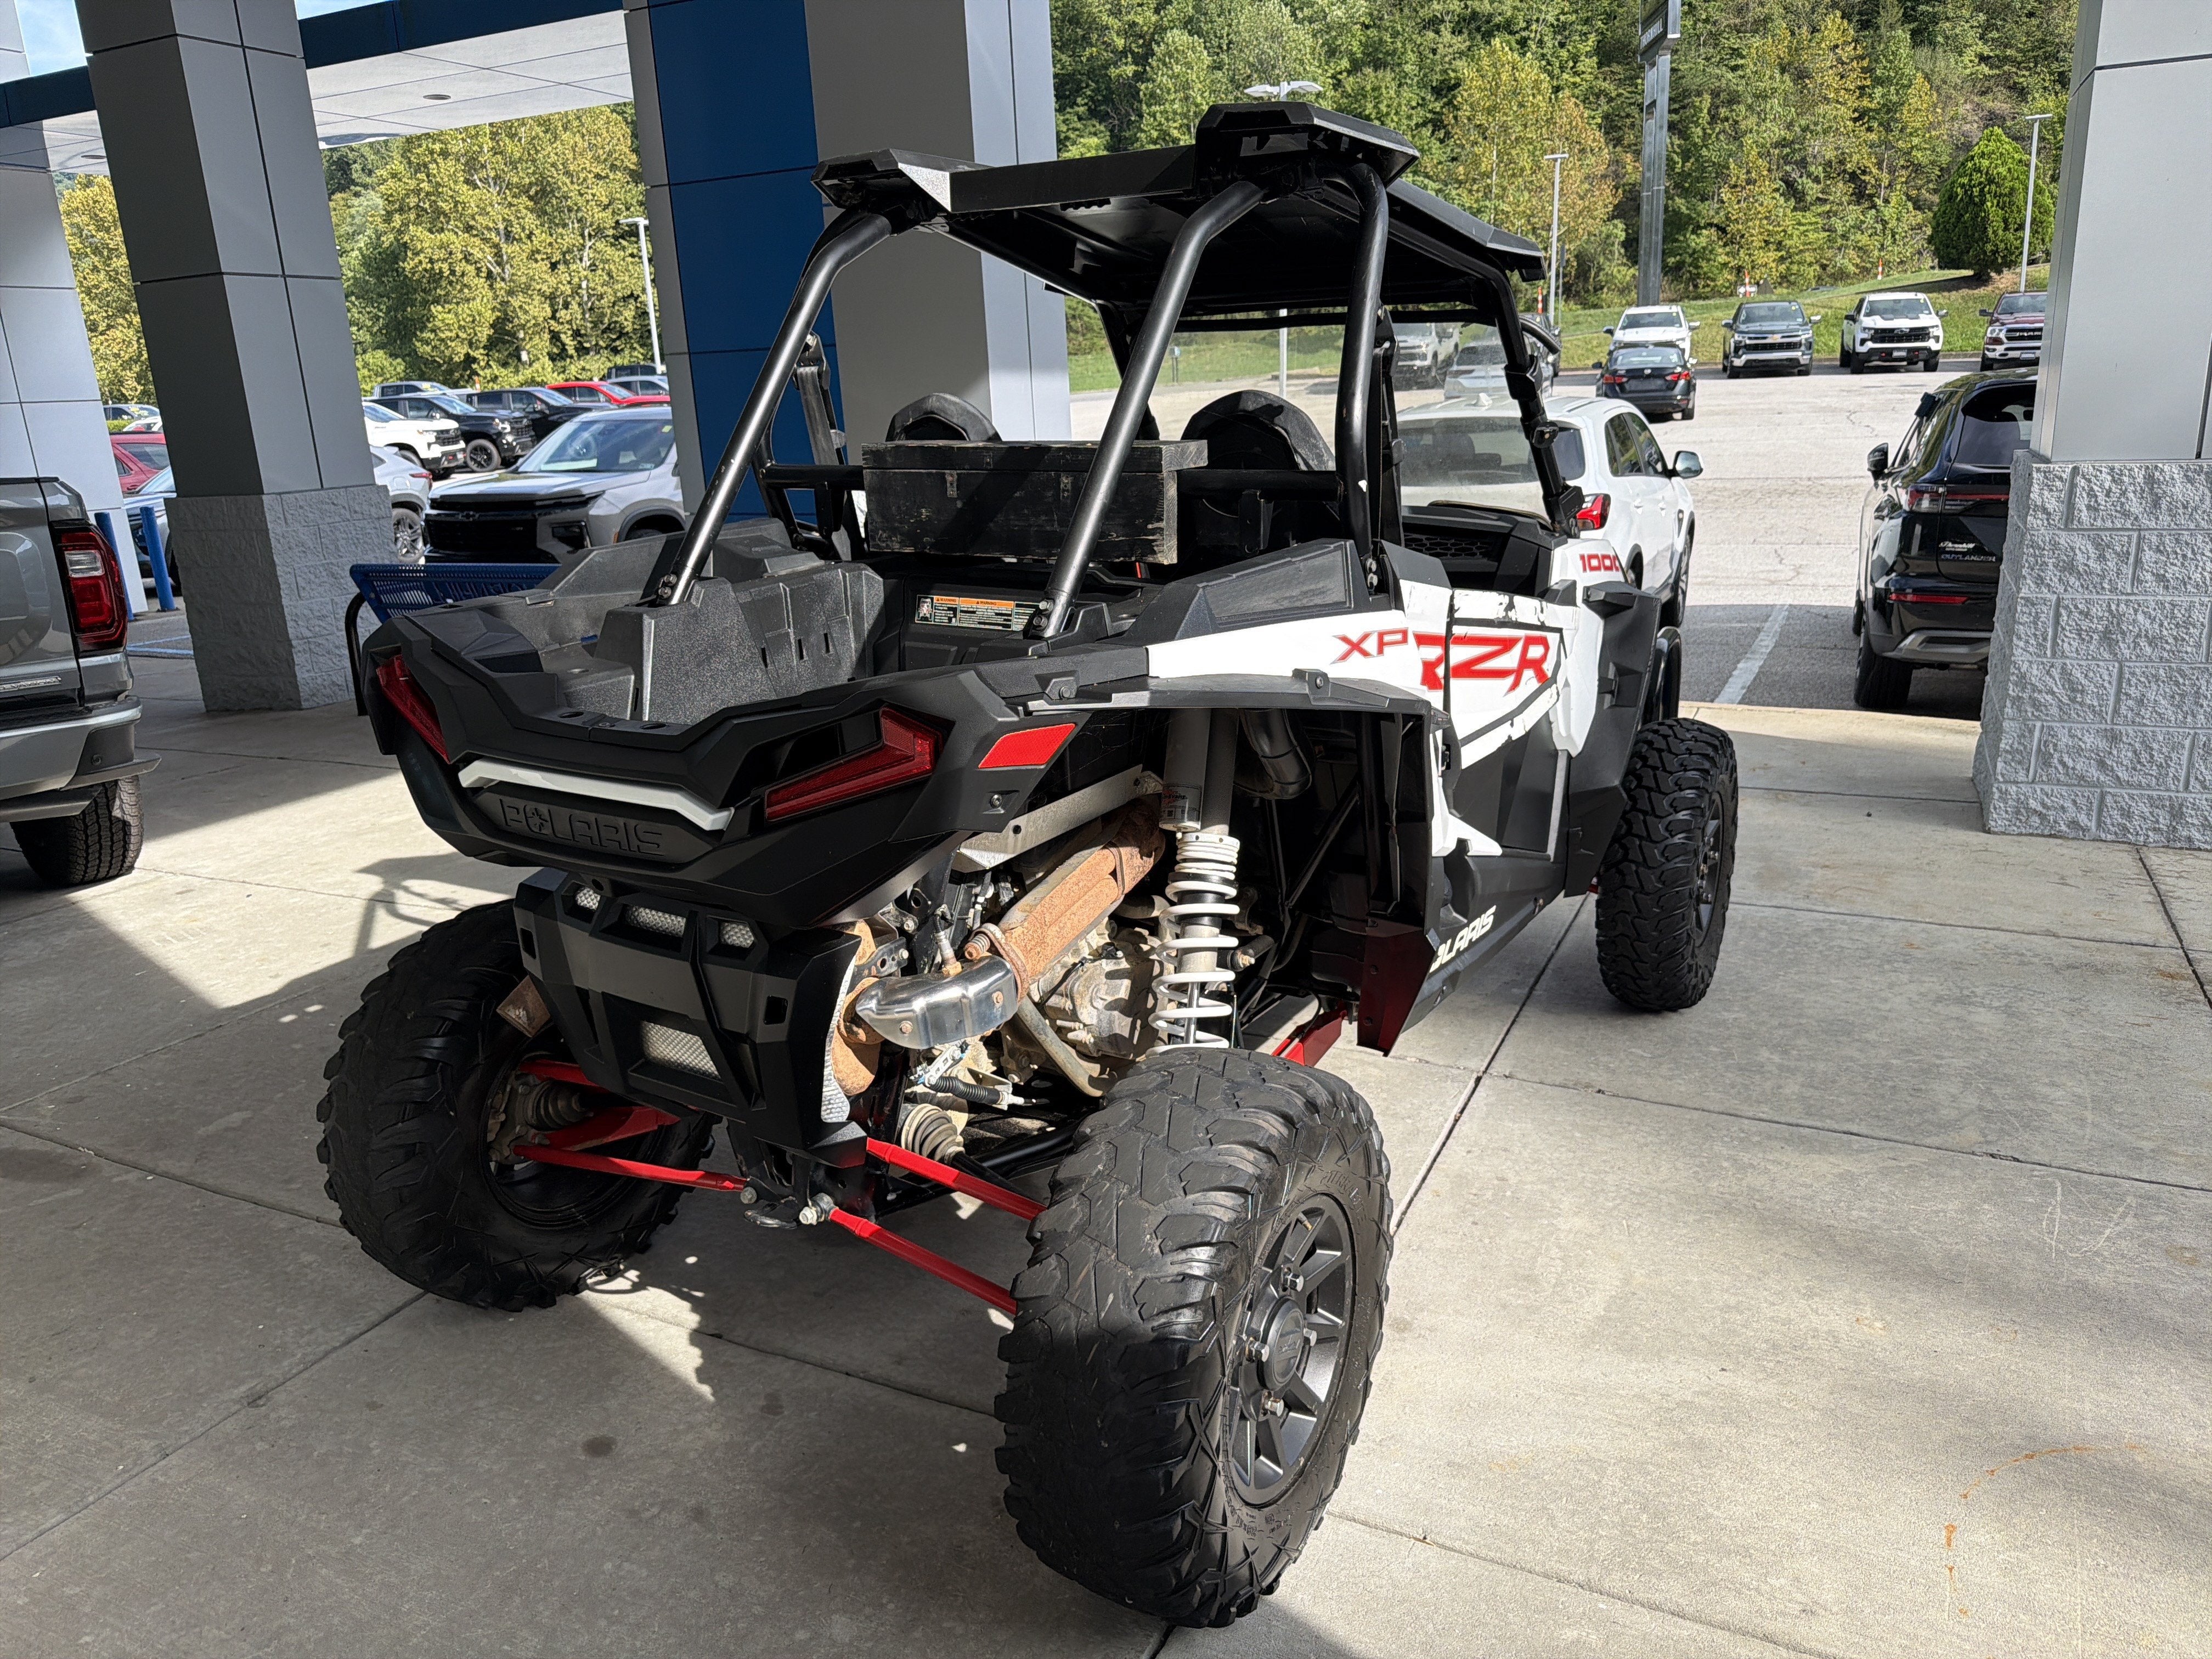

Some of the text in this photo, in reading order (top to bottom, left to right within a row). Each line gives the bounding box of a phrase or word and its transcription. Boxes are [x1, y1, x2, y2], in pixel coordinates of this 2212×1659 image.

[1329, 627, 1550, 697] XP RZR
[499, 798, 664, 856] POLARIS
